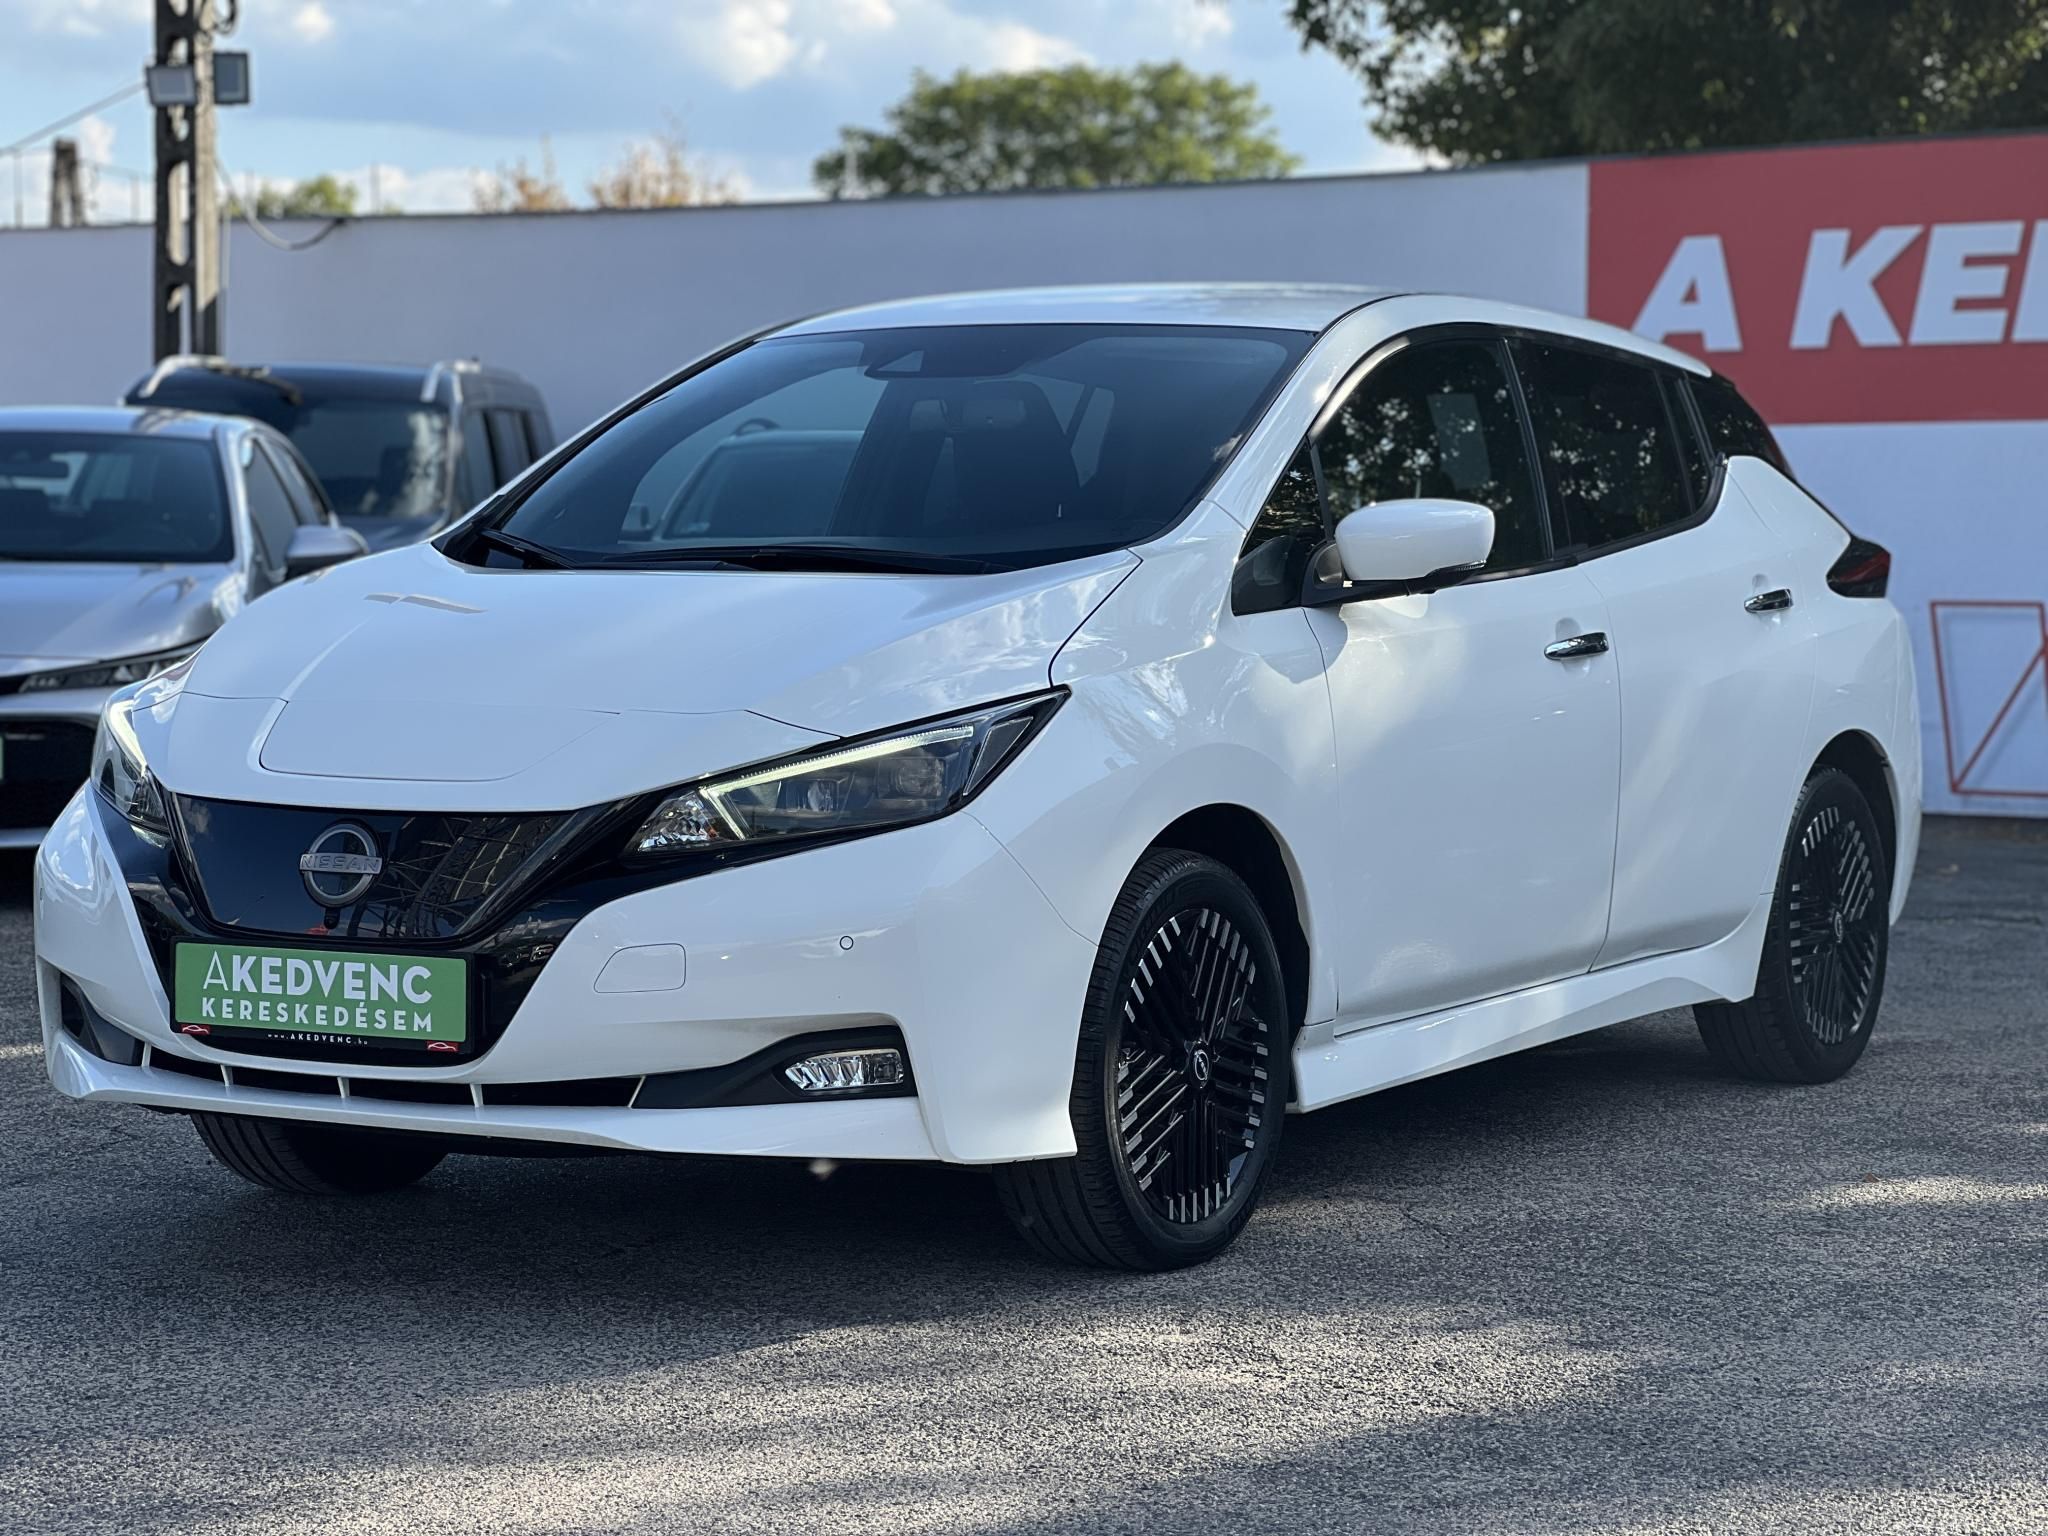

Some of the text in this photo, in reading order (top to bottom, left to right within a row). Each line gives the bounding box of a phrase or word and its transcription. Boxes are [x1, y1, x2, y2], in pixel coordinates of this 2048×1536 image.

[1630, 233, 1743, 352] A
[301, 854, 380, 873] NISSAN
[201, 997, 433, 1033] KERESKEDÉSEM
